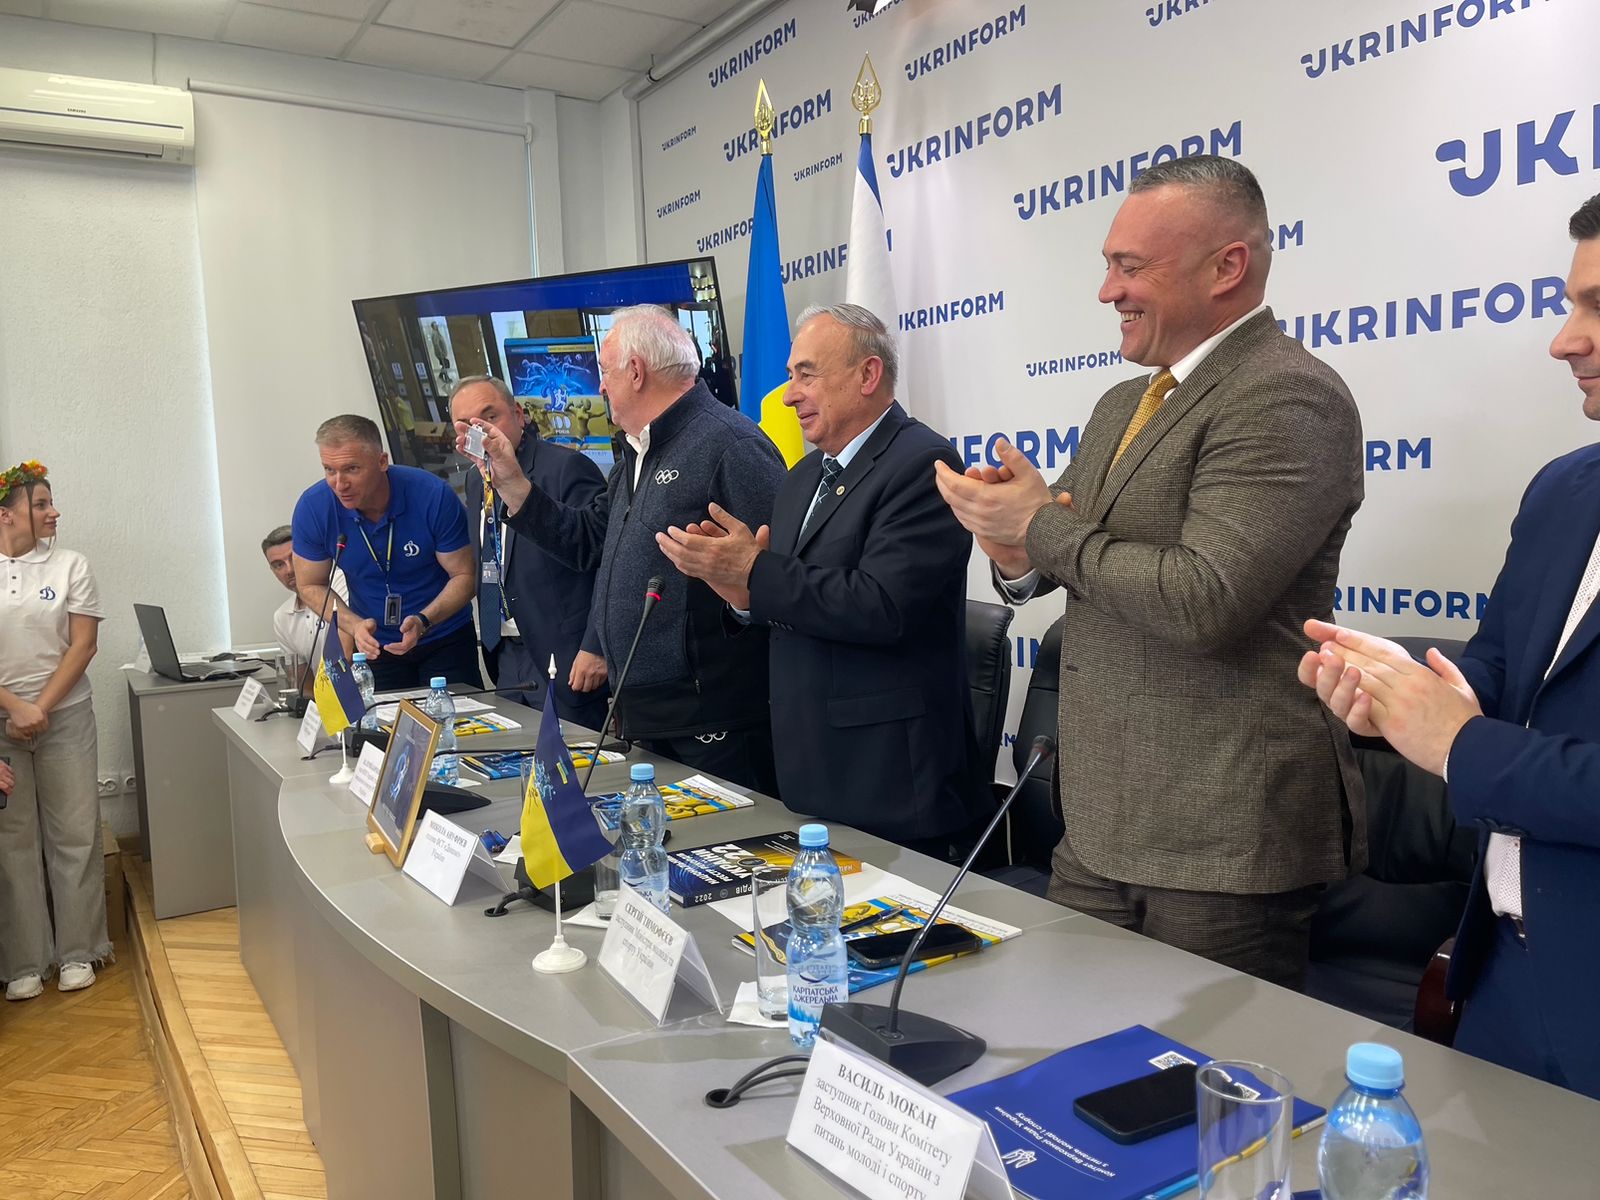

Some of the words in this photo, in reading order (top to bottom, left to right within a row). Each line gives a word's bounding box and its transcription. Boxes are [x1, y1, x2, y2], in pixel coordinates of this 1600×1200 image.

[708, 17, 797, 88] UKRINFORM
[905, 4, 1027, 82] UKRINFORM
[1300, 0, 1549, 79] UKRINFOR
[661, 125, 697, 151] UKRINFORM
[723, 89, 832, 162] UKRNFORM
[886, 83, 1063, 178] UKRINFORM
[793, 152, 843, 182] UKRINFORM
[656, 189, 701, 218] UKRINFORM
[1025, 350, 1123, 378] UKRINFORM
[694, 893, 713, 903] 2022
[792, 984, 839, 997] КАРПАТСЬКА
[793, 994, 839, 1005] ДЖЕРЕЛЬНА
[815, 1078, 862, 1113] заступник
[863, 1102, 900, 1135] Голови
[900, 1124, 953, 1168] Комітету
[838, 1063, 885, 1101] ВАСИЛЬ
[886, 1090, 938, 1130] МОКАН
[813, 1096, 861, 1136] Верховної
[861, 1126, 886, 1153] Ради
[888, 1141, 932, 1182] України
[814, 1124, 846, 1151] питань
[845, 1145, 882, 1175] молоді
[888, 1172, 927, 1200] спорту
